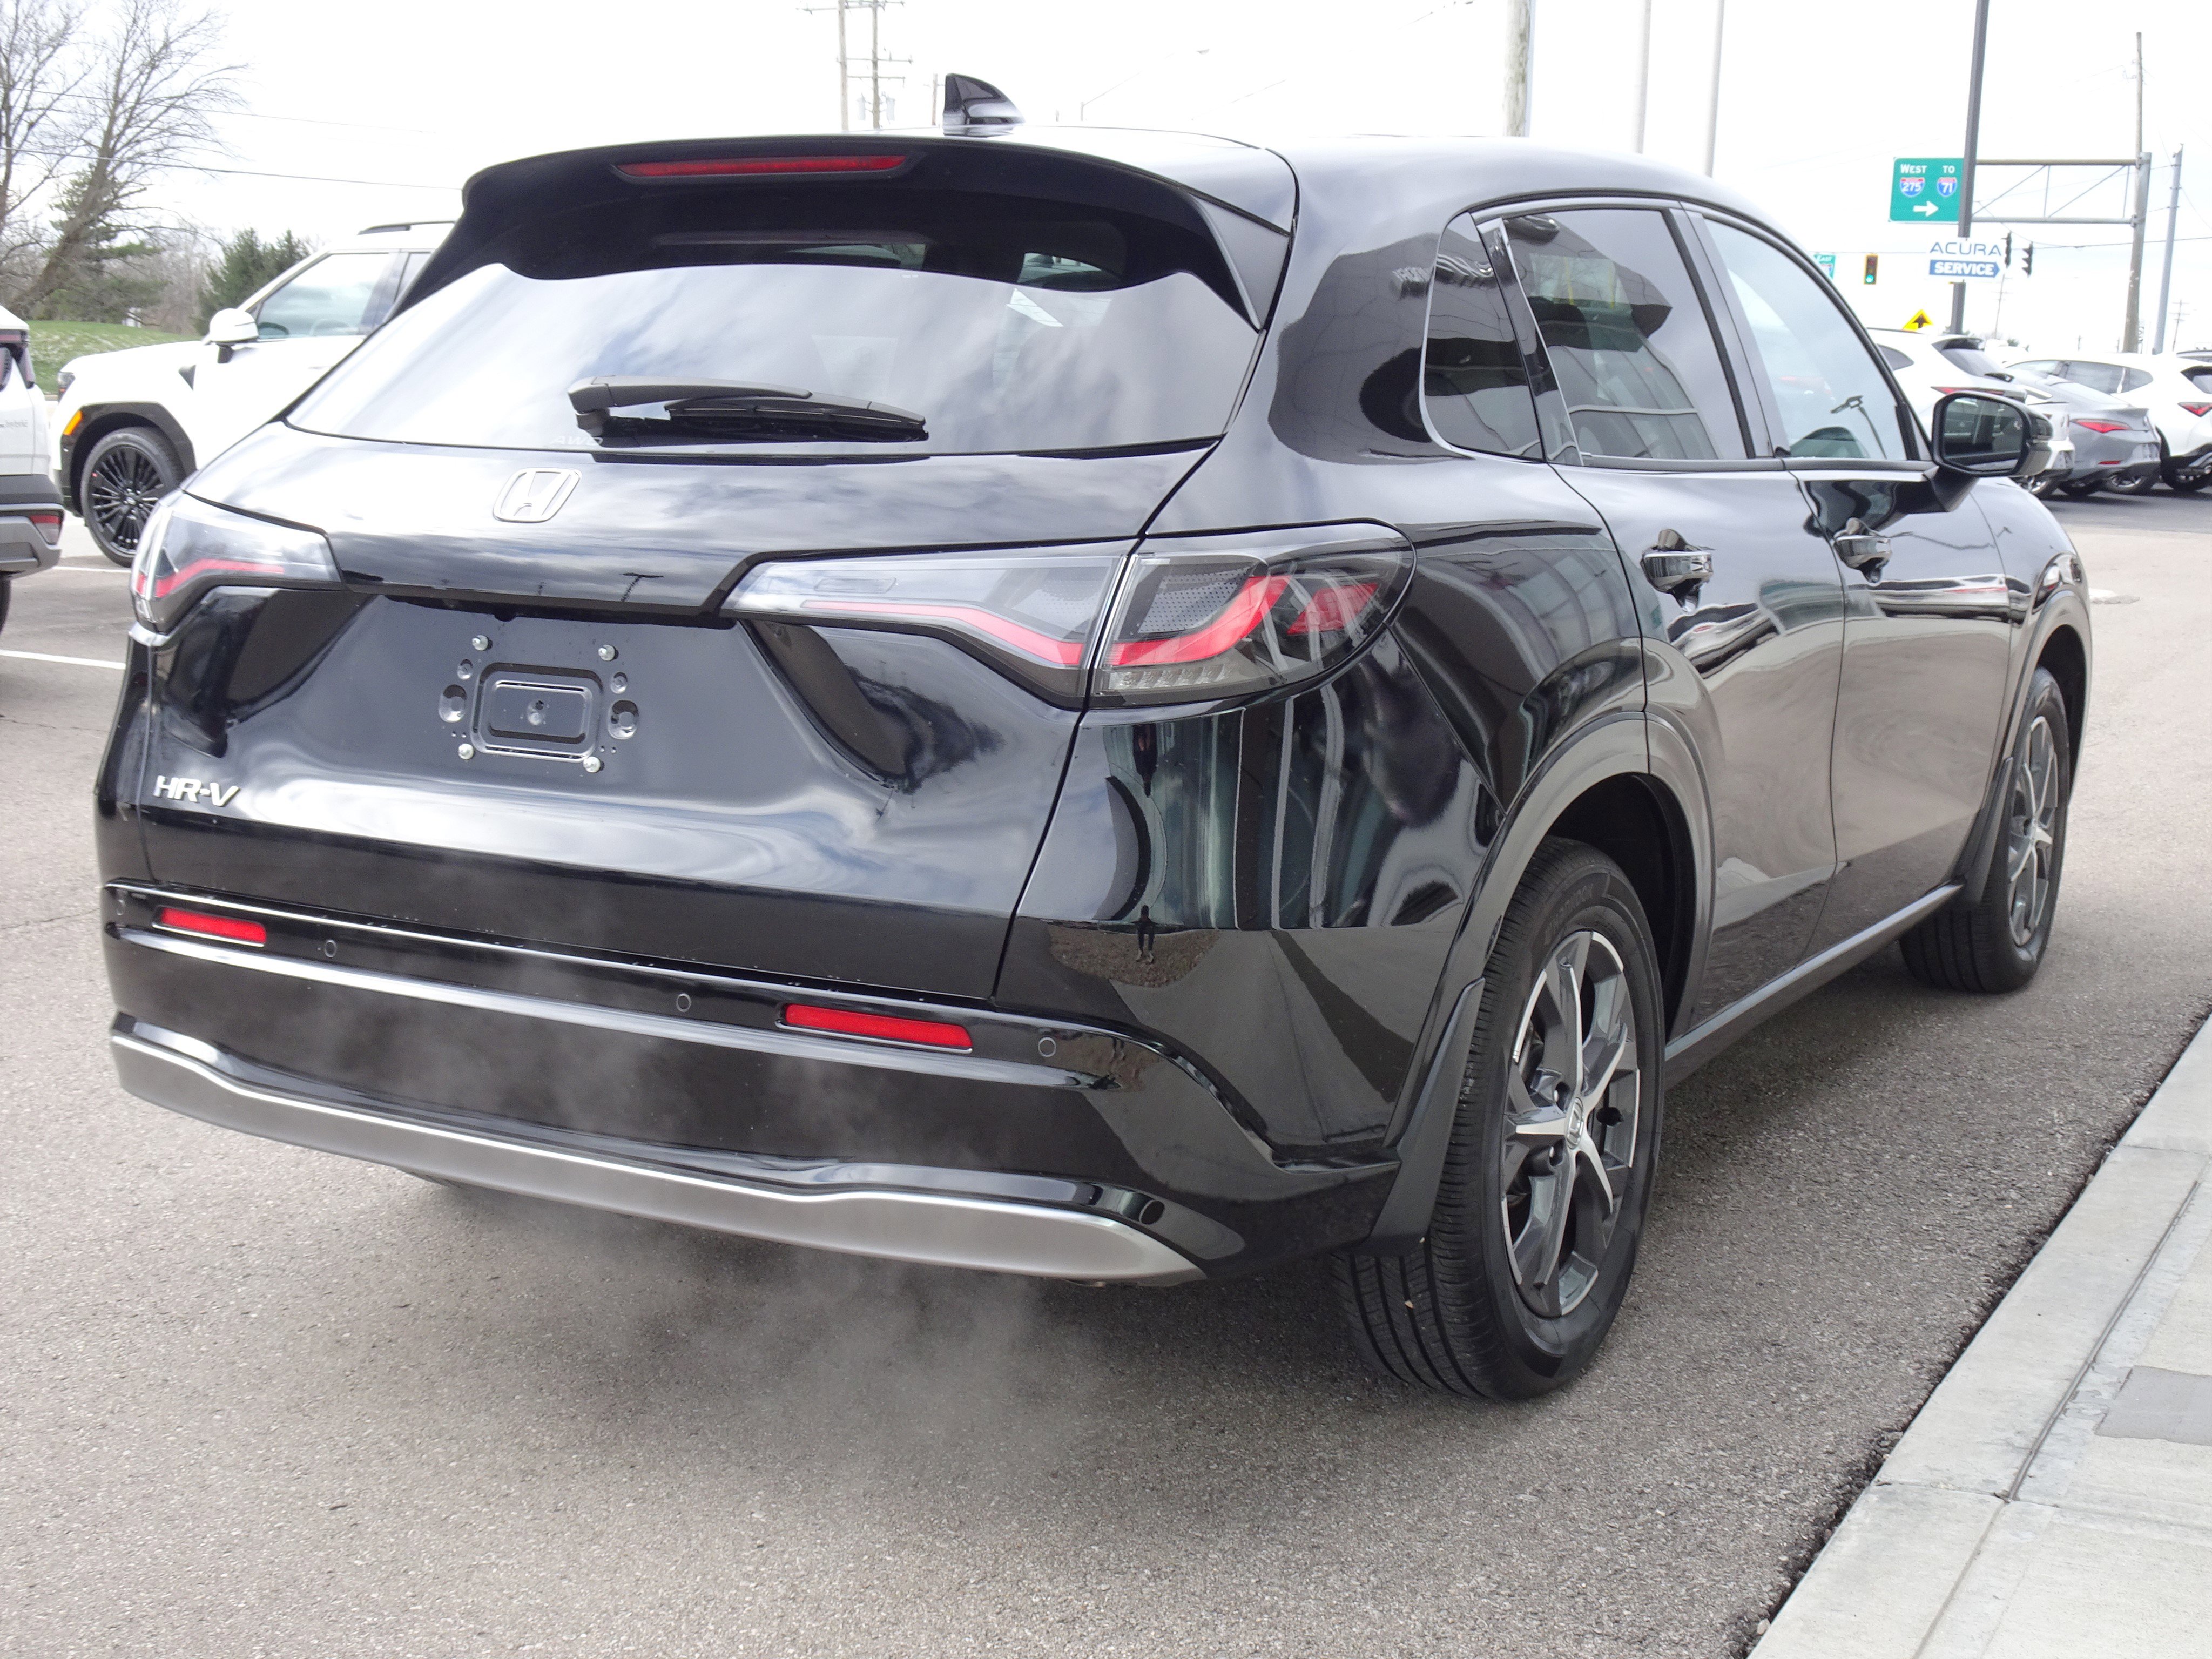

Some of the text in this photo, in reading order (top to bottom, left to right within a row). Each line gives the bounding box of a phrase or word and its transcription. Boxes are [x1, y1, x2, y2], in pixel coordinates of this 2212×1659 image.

[1900, 164, 1955, 174] WEST TO
[1902, 182, 1953, 193] 275 71
[1930, 242, 2001, 256] ACURA
[1934, 261, 1994, 275] SERVICE
[153, 775, 241, 807] HR-V
